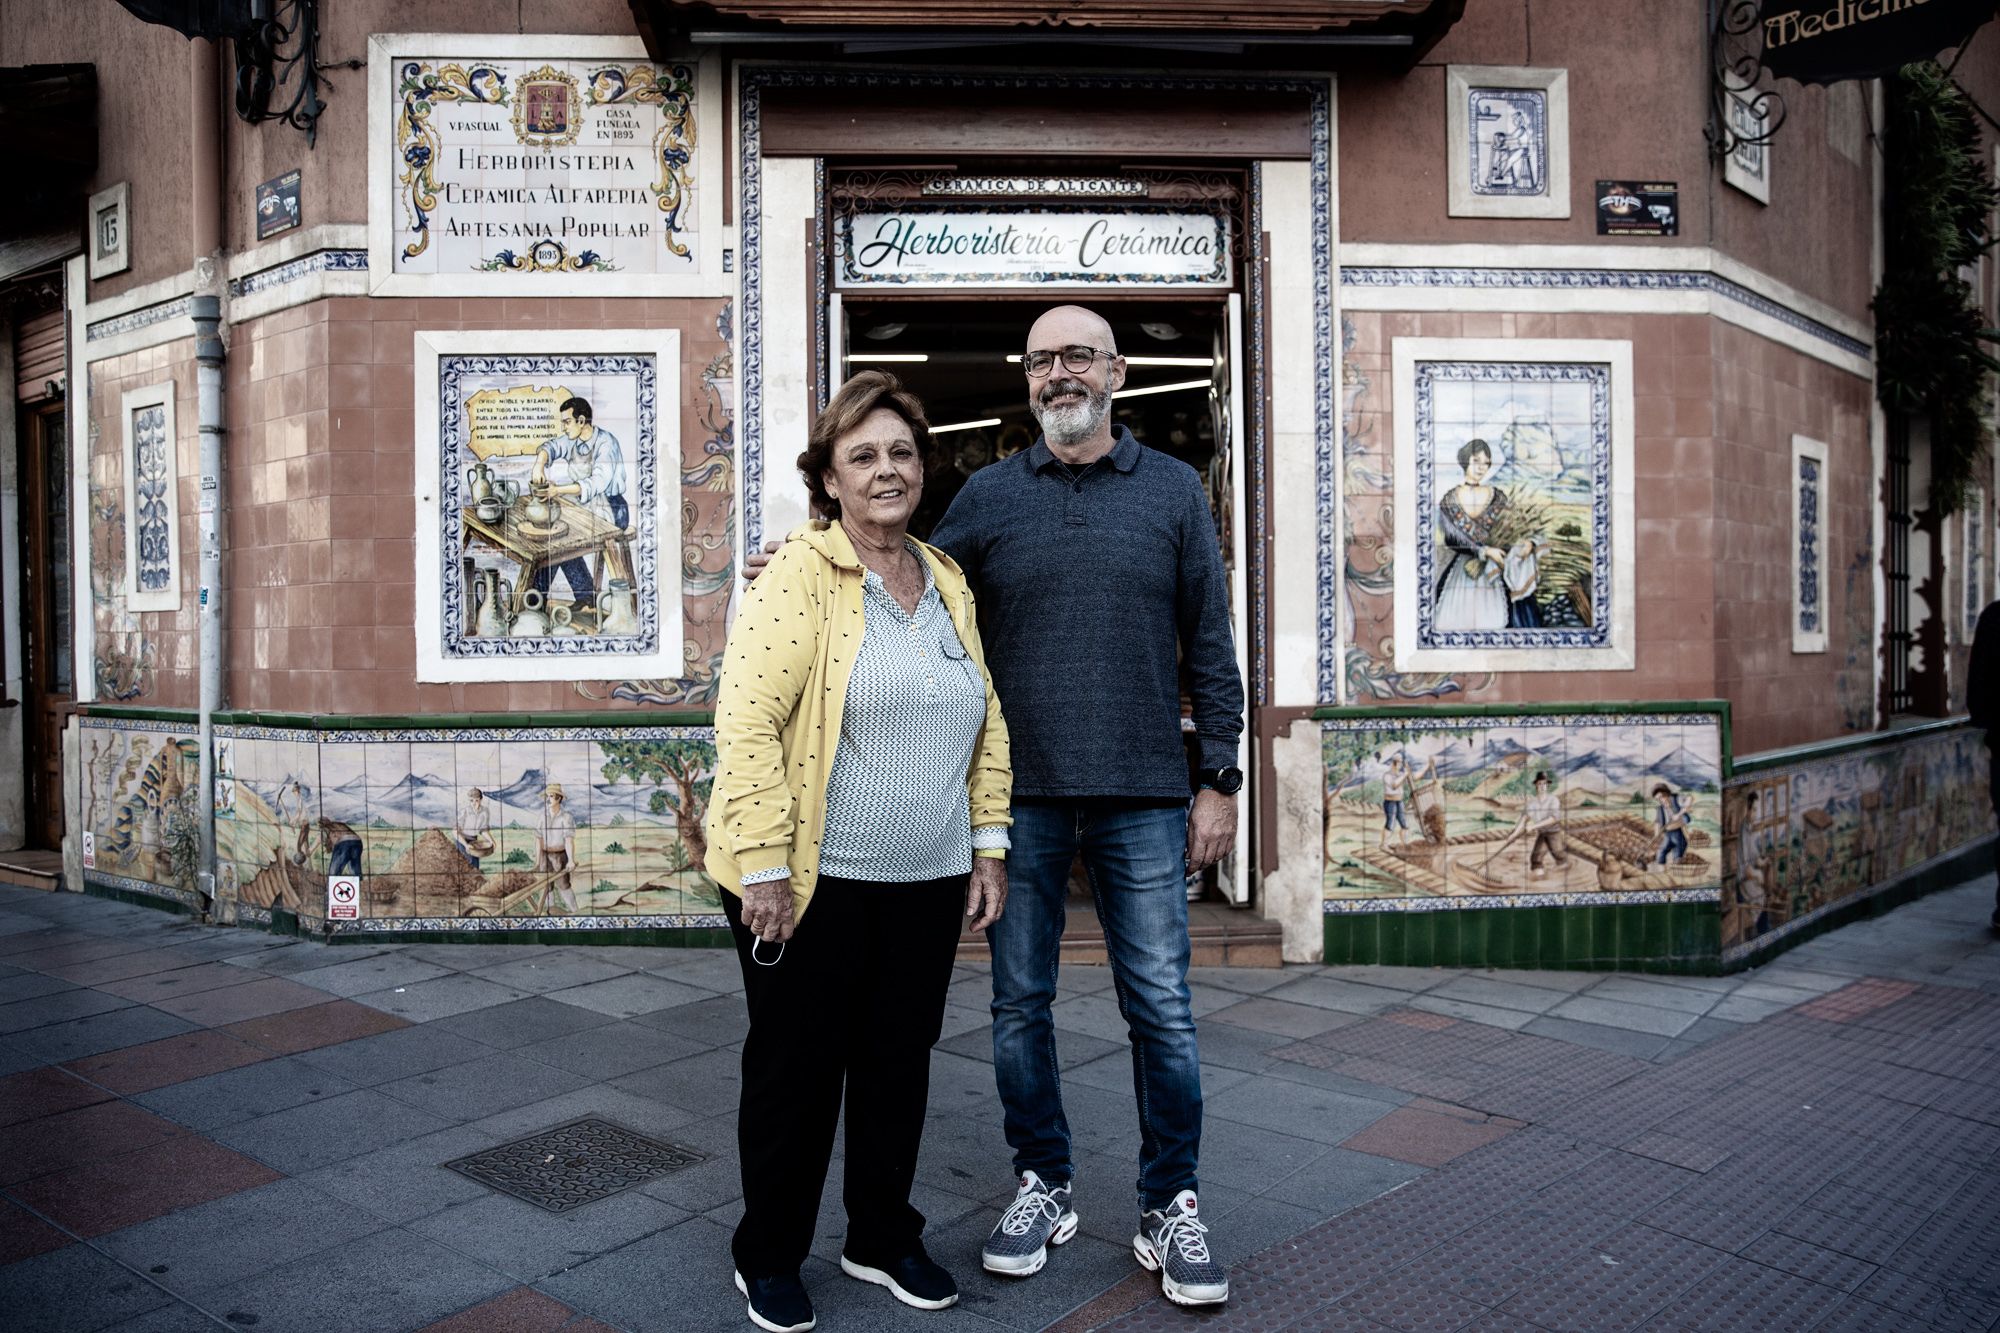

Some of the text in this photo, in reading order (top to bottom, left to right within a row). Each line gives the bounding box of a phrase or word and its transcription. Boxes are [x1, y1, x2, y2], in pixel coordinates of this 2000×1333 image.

[606, 109, 631, 118] CASA
[597, 119, 640, 129] FUNDADA
[597, 130, 610, 139] EN
[459, 148, 634, 170] HERBORISTERIA
[446, 182, 648, 204] CERAMICA ALFARERIA
[933, 180, 1137, 192] CERAMICA DE ALICANTE
[105, 218, 117, 246] 15
[445, 216, 649, 237] ARTESANIA POPULAR
